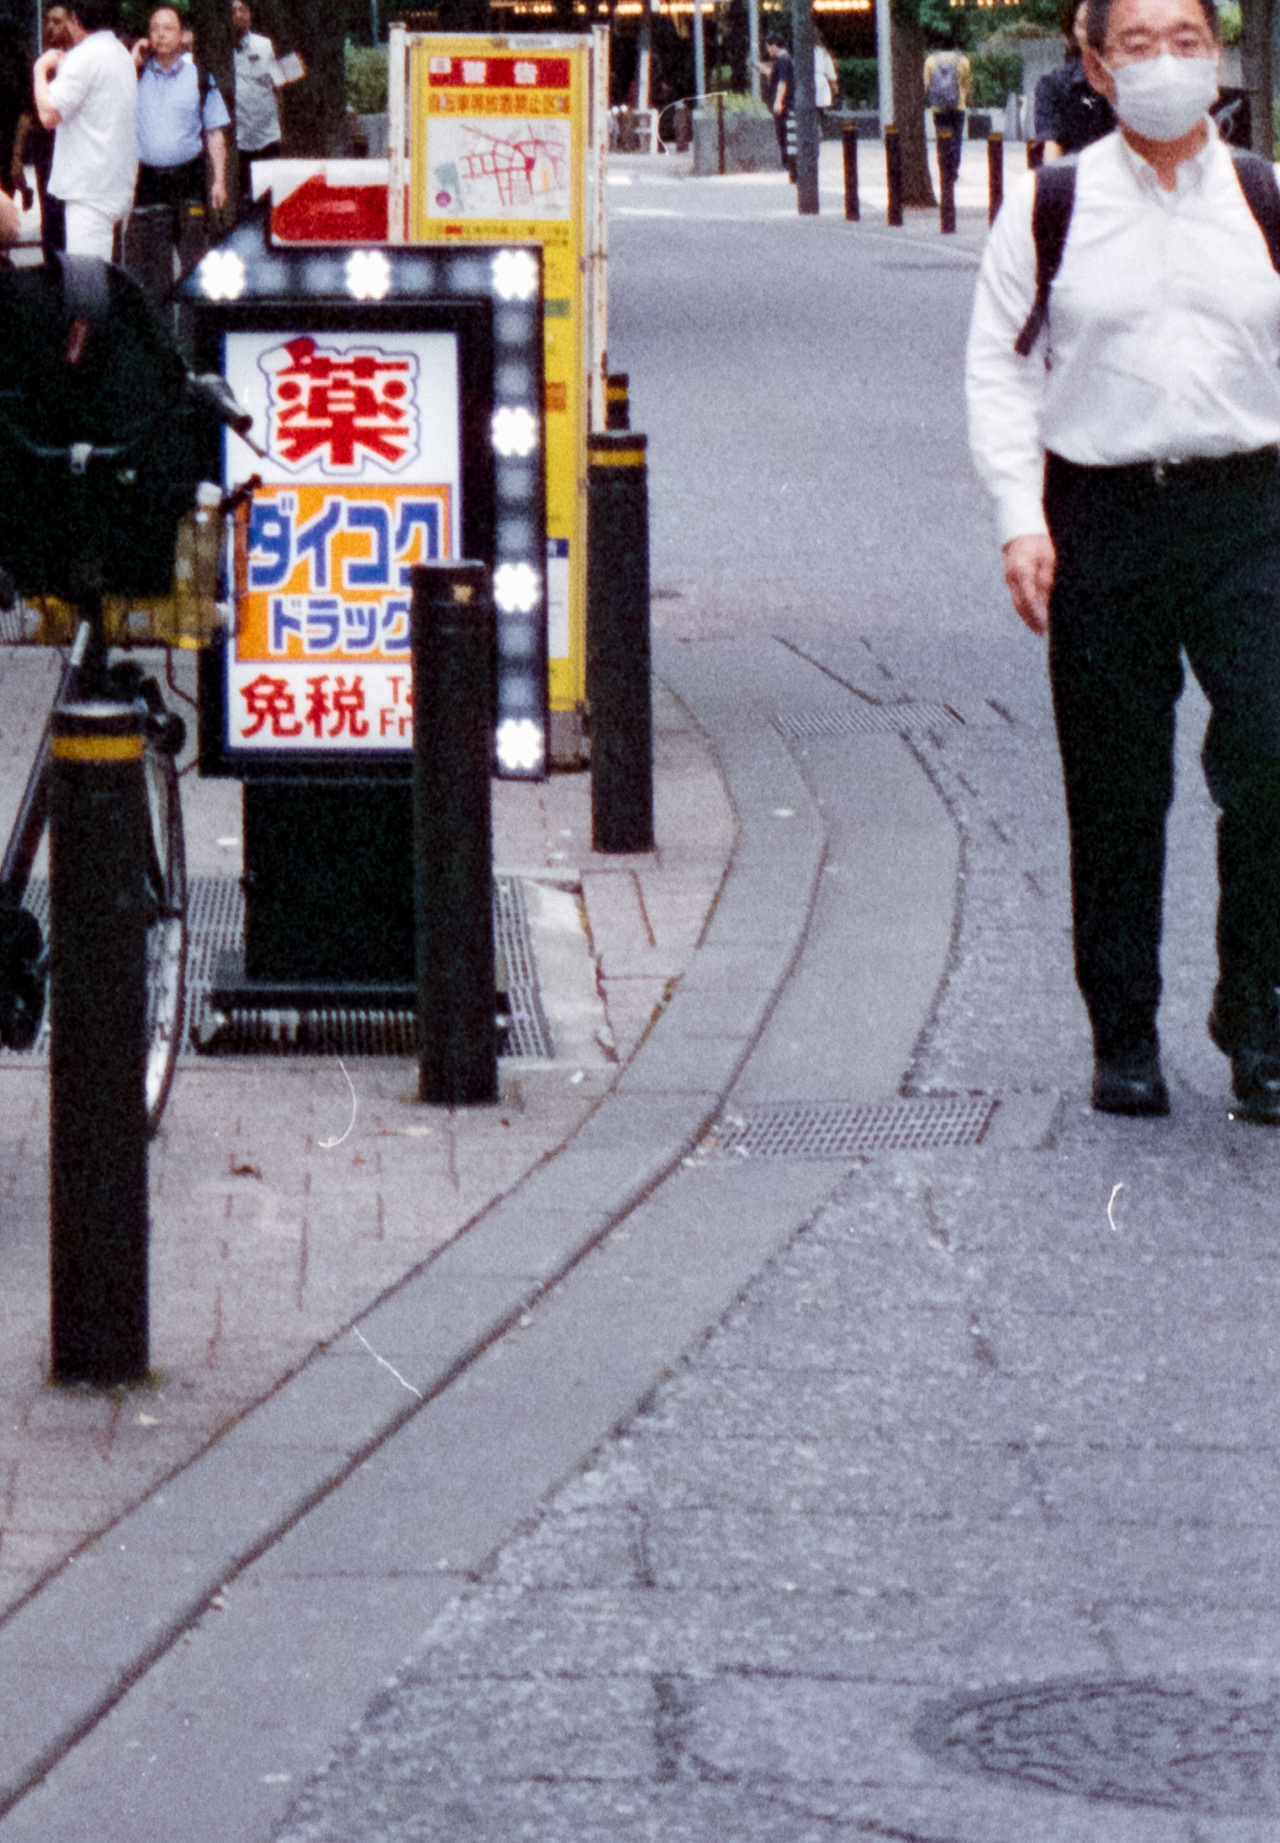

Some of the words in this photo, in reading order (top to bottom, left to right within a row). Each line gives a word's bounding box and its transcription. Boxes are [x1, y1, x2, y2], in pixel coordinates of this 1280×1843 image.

[274, 344, 412, 468] 薬
[247, 497, 441, 589] ダイコク
[239, 673, 370, 739] 免税
